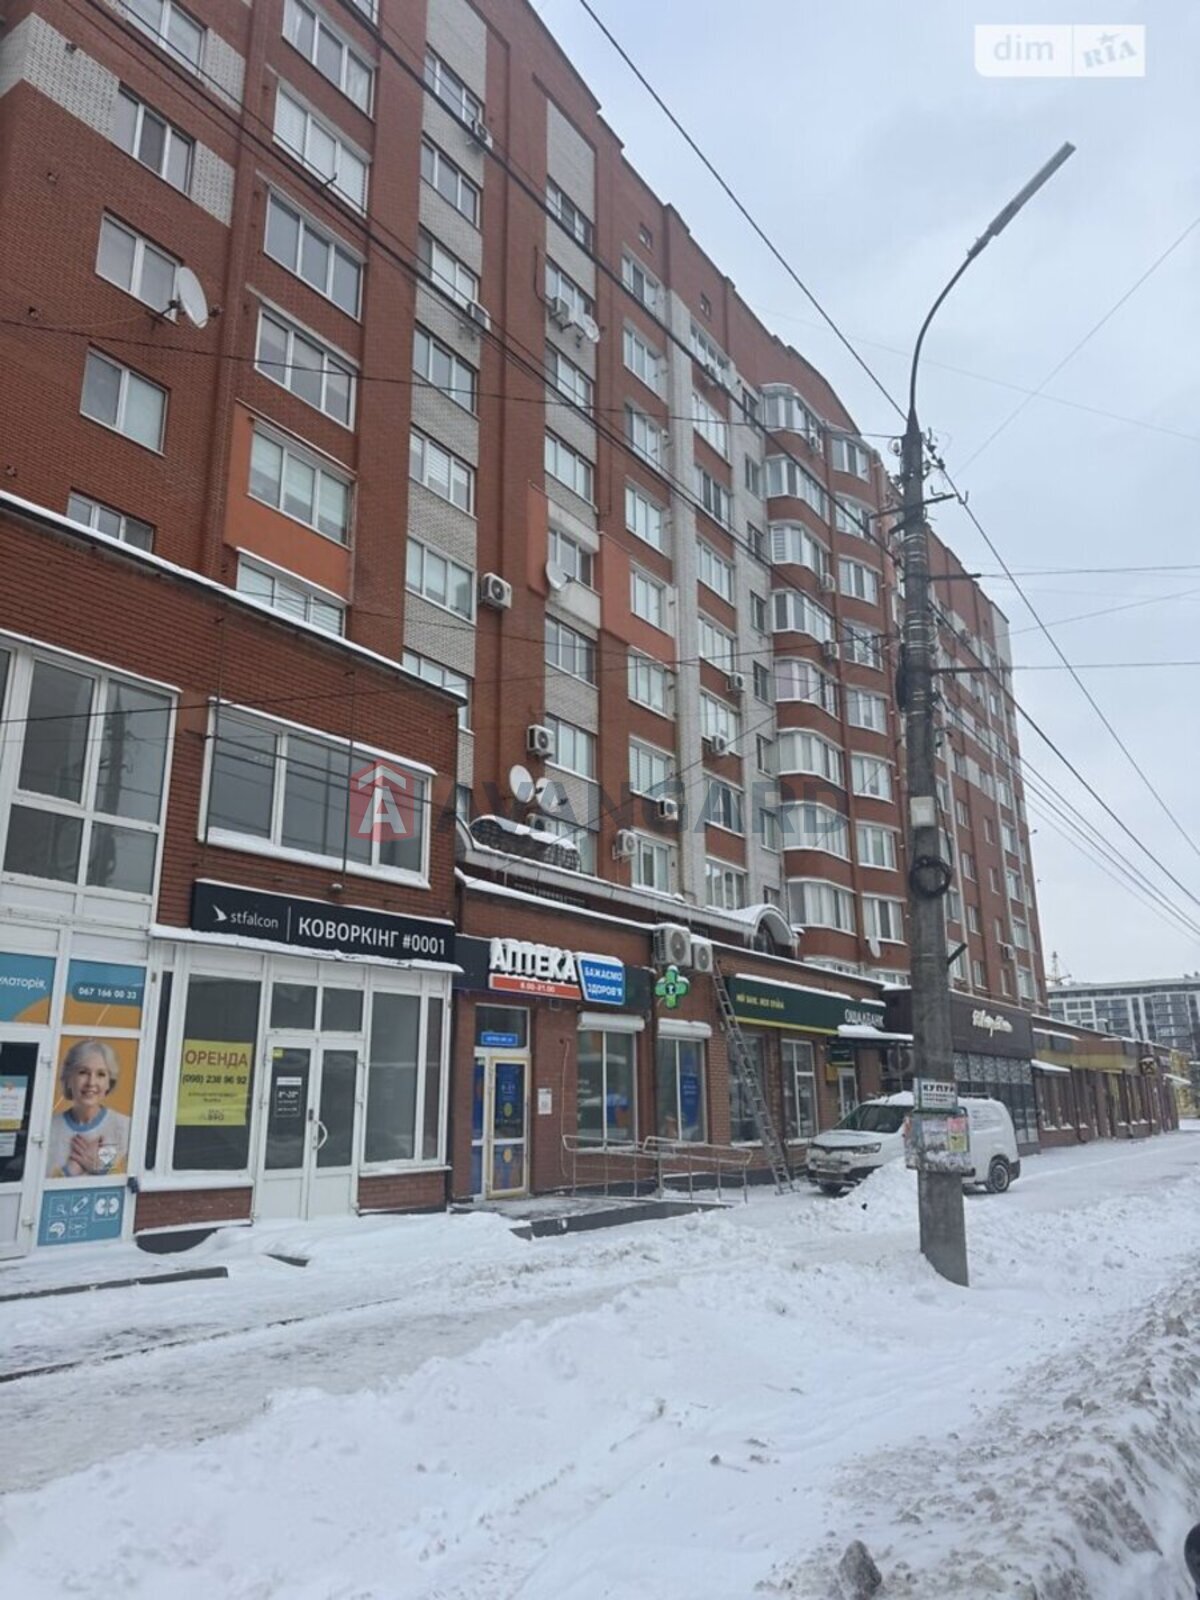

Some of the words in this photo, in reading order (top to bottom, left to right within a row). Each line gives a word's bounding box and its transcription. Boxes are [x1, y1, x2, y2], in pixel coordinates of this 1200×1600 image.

[230, 910, 279, 929] stfalcon
[298, 917, 399, 948] КОВОРКІНГ
[402, 934, 446, 955] #0001
[489, 938, 579, 983] АПТЕКА
[78, 987, 94, 996] 067
[127, 991, 137, 999] 33
[185, 1050, 248, 1069] ОРЕНДА
